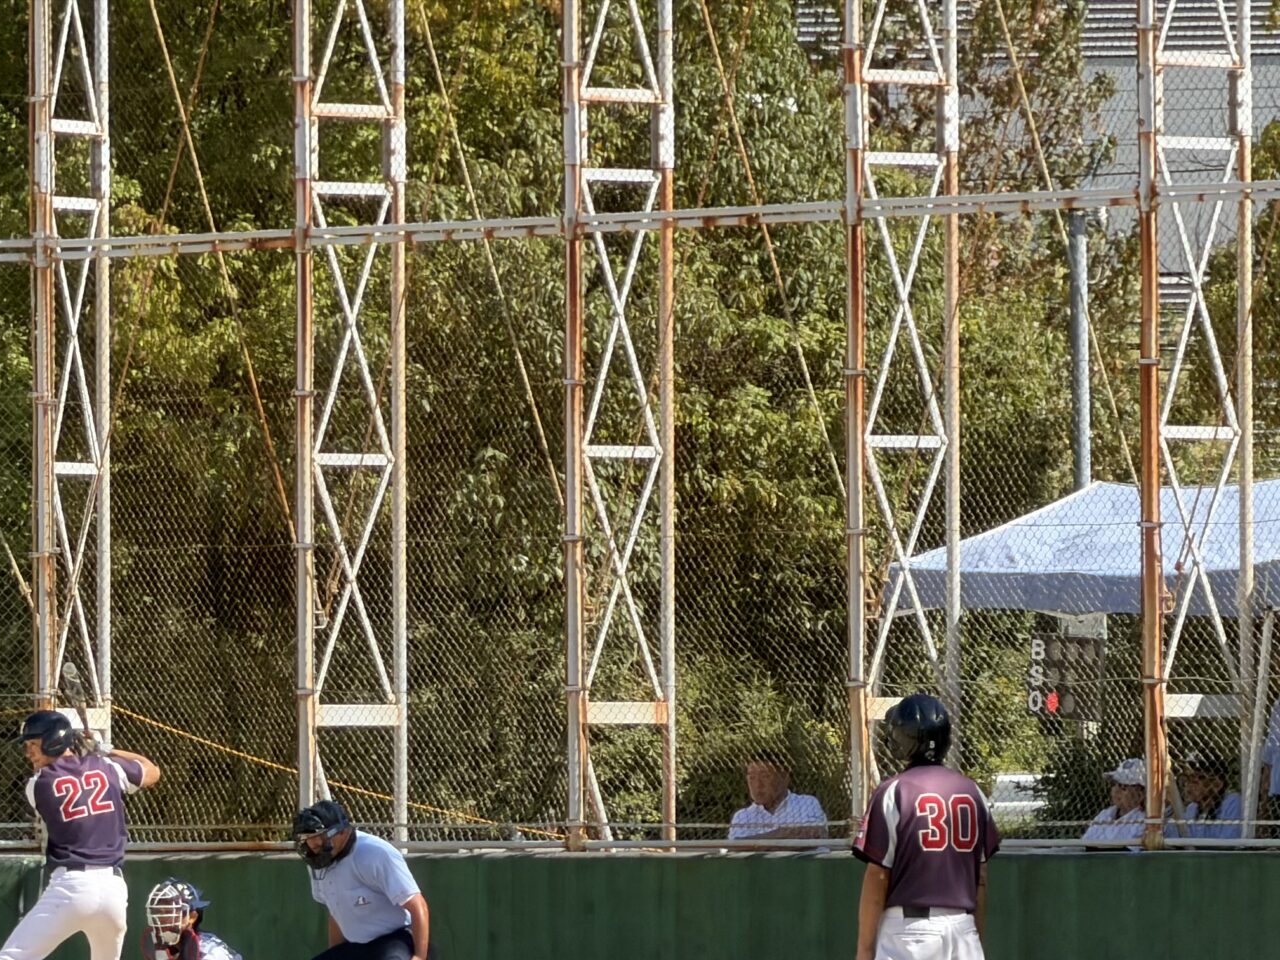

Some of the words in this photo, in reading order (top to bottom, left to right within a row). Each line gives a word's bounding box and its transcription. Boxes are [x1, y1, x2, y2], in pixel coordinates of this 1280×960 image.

[1031, 640, 1046, 660] B
[1030, 665, 1044, 686] S
[1028, 691, 1042, 712] O
[53, 770, 115, 822] 22
[915, 793, 979, 852] 30
